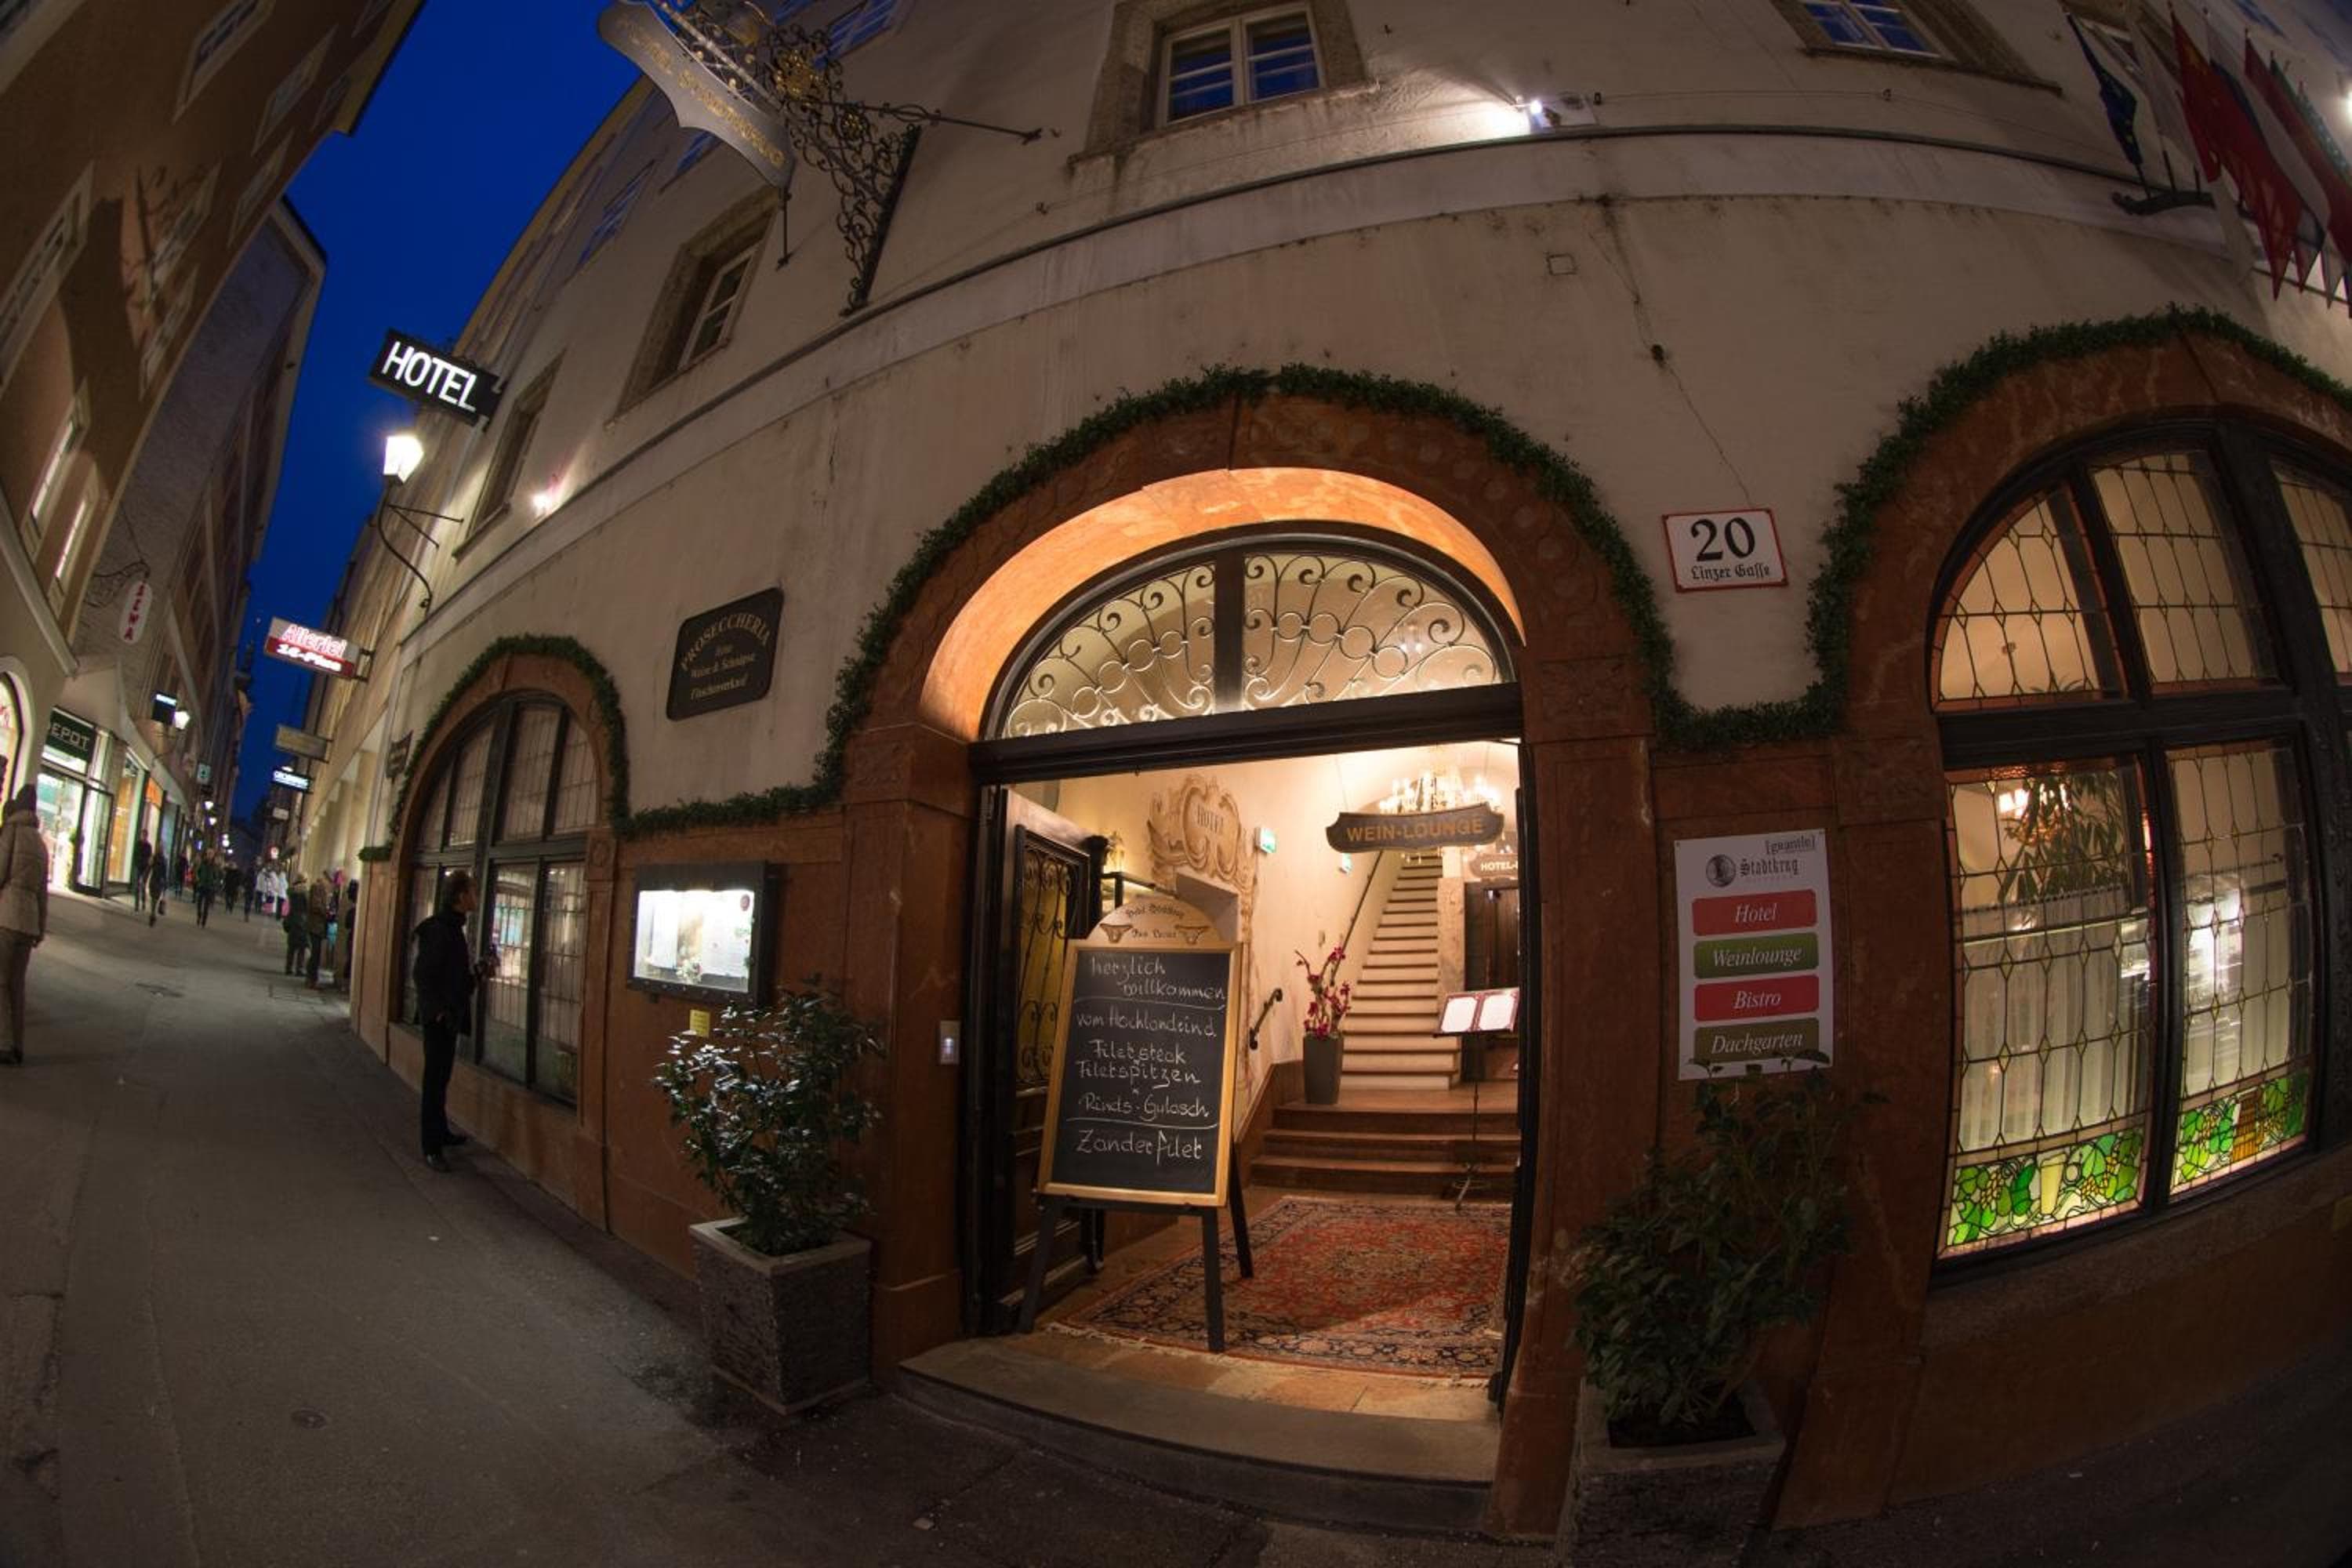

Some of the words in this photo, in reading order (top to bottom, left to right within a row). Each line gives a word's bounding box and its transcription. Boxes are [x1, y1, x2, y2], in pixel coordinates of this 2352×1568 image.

[381, 340, 477, 412] HOTEL
[1690, 517, 1755, 562] 20
[1690, 564, 1732, 582] Linzer
[49, 720, 91, 752] EPOT
[1739, 858, 1799, 877] Stadtkrug
[1734, 903, 1777, 924] Hotel
[1712, 946, 1802, 967] Weinlounge
[1123, 979, 1225, 1000] willkommen
[1733, 990, 1782, 1010] Bistro
[1711, 1030, 1804, 1055] Dachgarten
